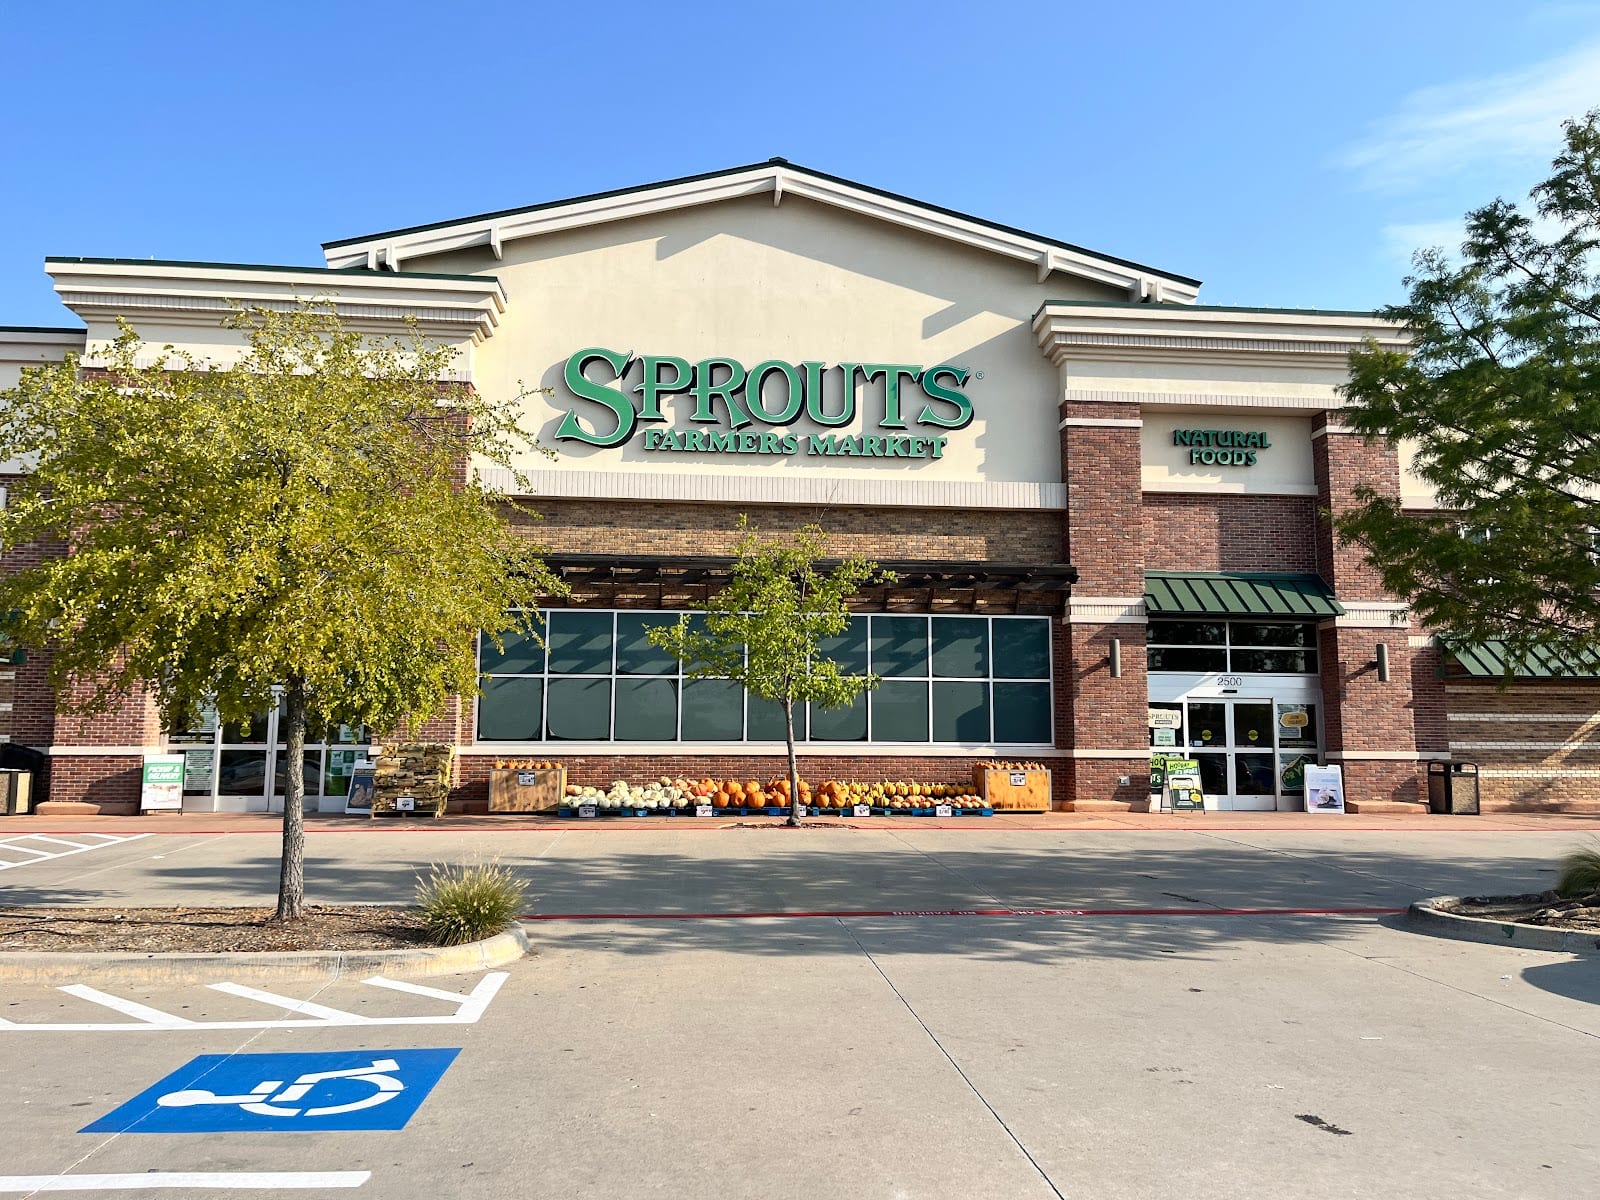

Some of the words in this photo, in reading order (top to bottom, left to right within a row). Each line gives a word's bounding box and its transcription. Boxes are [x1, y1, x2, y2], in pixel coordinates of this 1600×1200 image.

[555, 347, 973, 448] SPROUTS
[643, 429, 799, 456] FARMERS
[808, 433, 948, 459] MARKET
[1174, 429, 1272, 448] NATURAL
[1190, 448, 1258, 466] FOODS
[1217, 676, 1242, 686] 2500
[147, 772, 181, 780] DELIVERY
